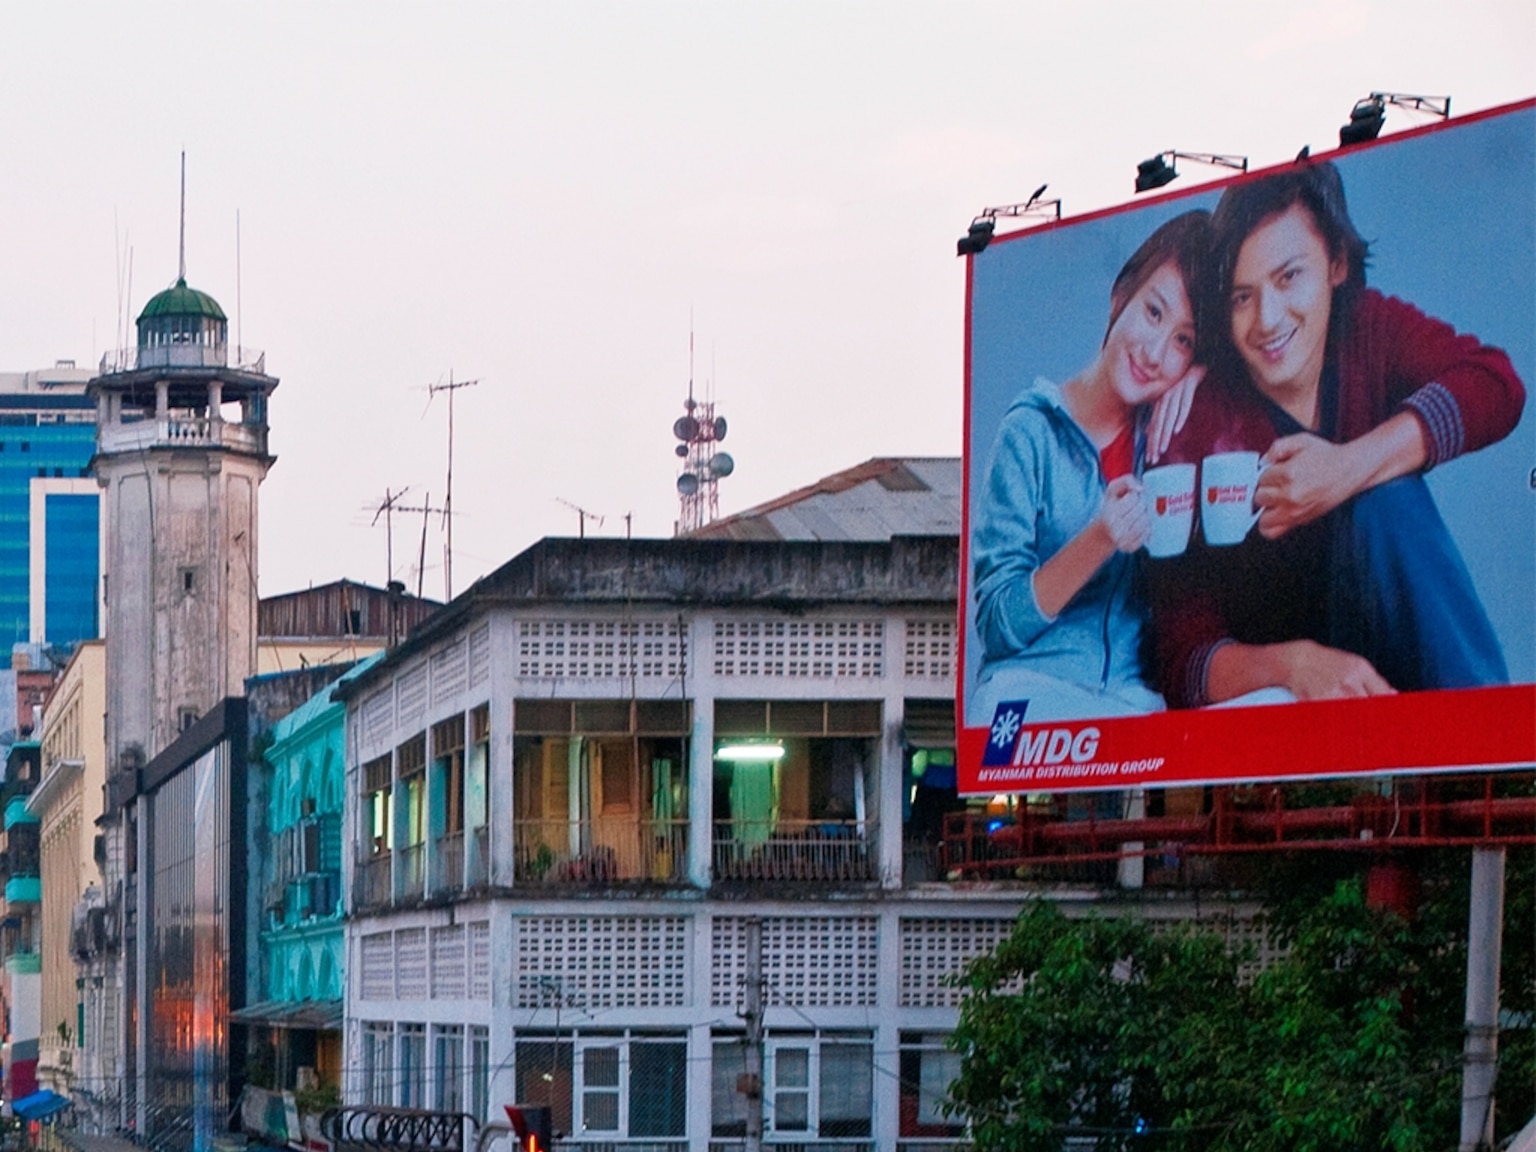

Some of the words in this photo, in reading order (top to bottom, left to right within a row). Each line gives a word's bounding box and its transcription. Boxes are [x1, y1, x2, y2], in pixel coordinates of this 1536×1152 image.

[1013, 727, 1101, 767] MDG
[978, 768, 1033, 782] MYANMAR
[1035, 763, 1117, 779] DISTRIBUTION
[1120, 758, 1165, 775] GROUP
